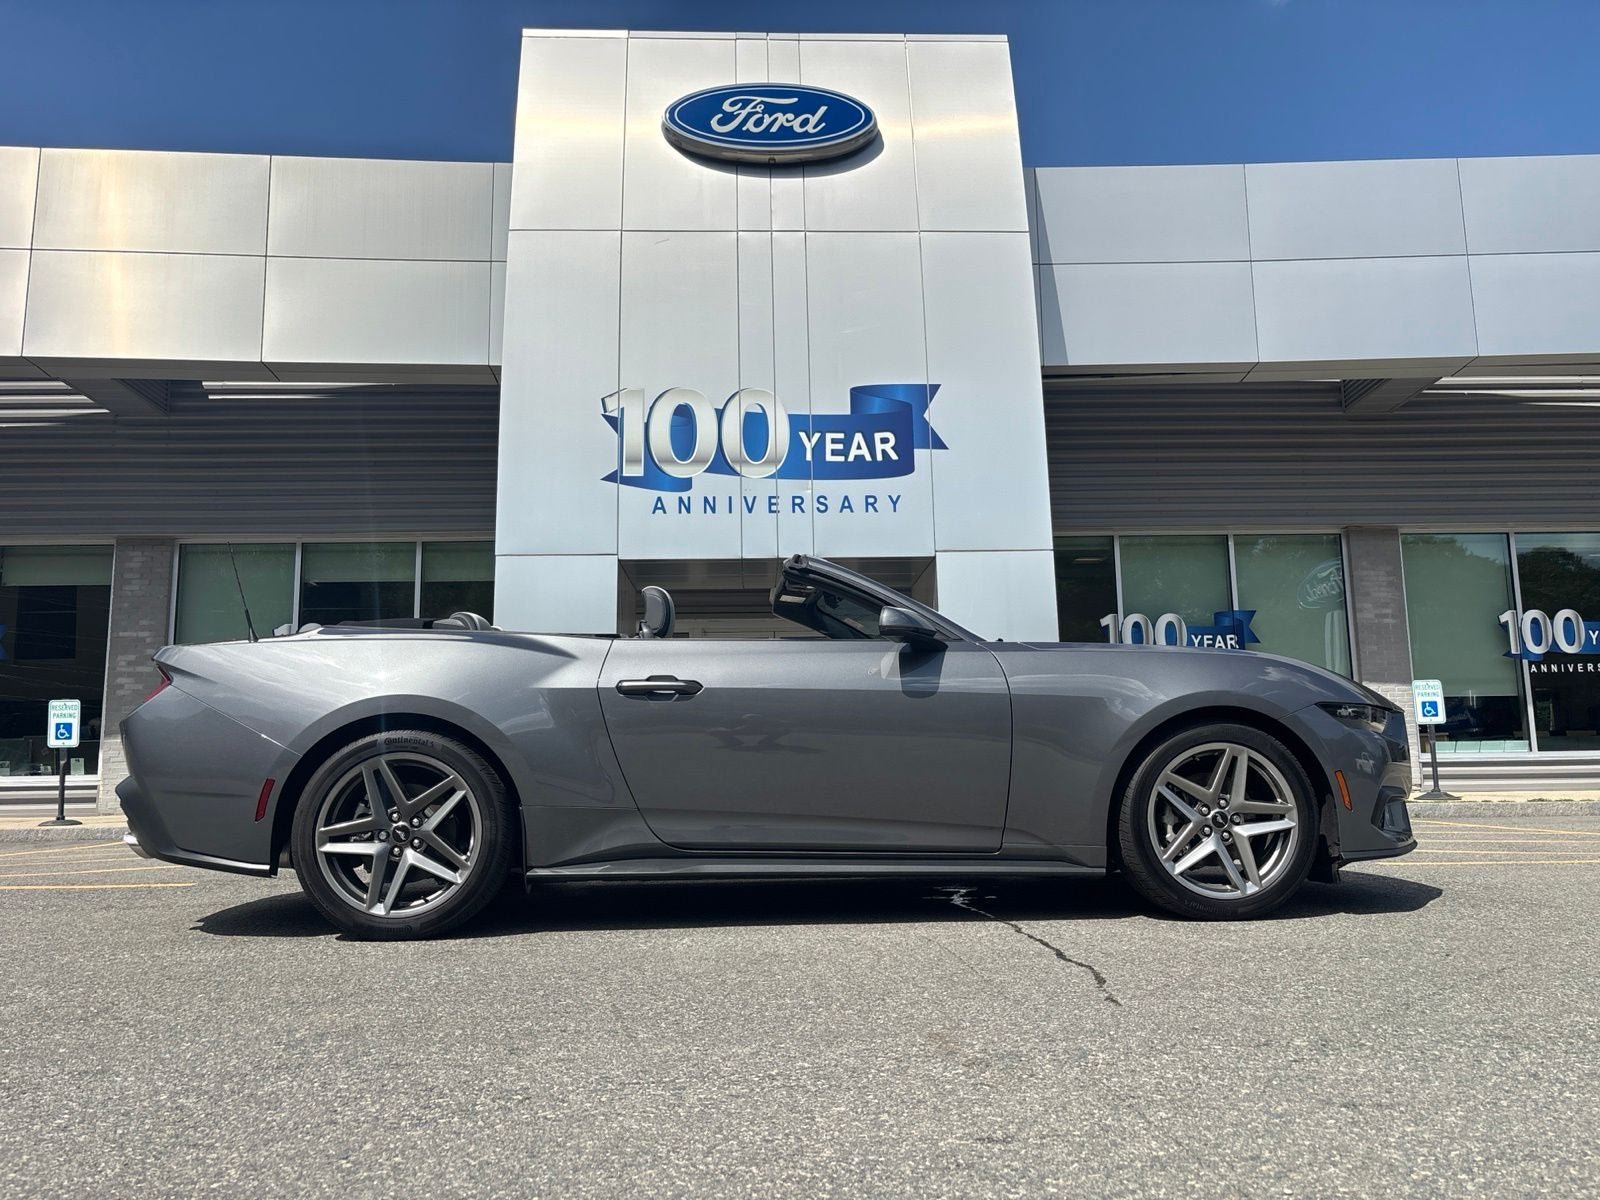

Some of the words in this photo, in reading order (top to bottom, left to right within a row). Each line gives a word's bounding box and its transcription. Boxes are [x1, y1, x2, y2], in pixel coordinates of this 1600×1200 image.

[710, 95, 828, 133] Ford
[601, 387, 790, 478] 100
[798, 431, 899, 462] YEAR
[652, 495, 902, 514] ANNIVERSARY
[1100, 613, 1188, 647] 100
[1499, 608, 1585, 654] 100
